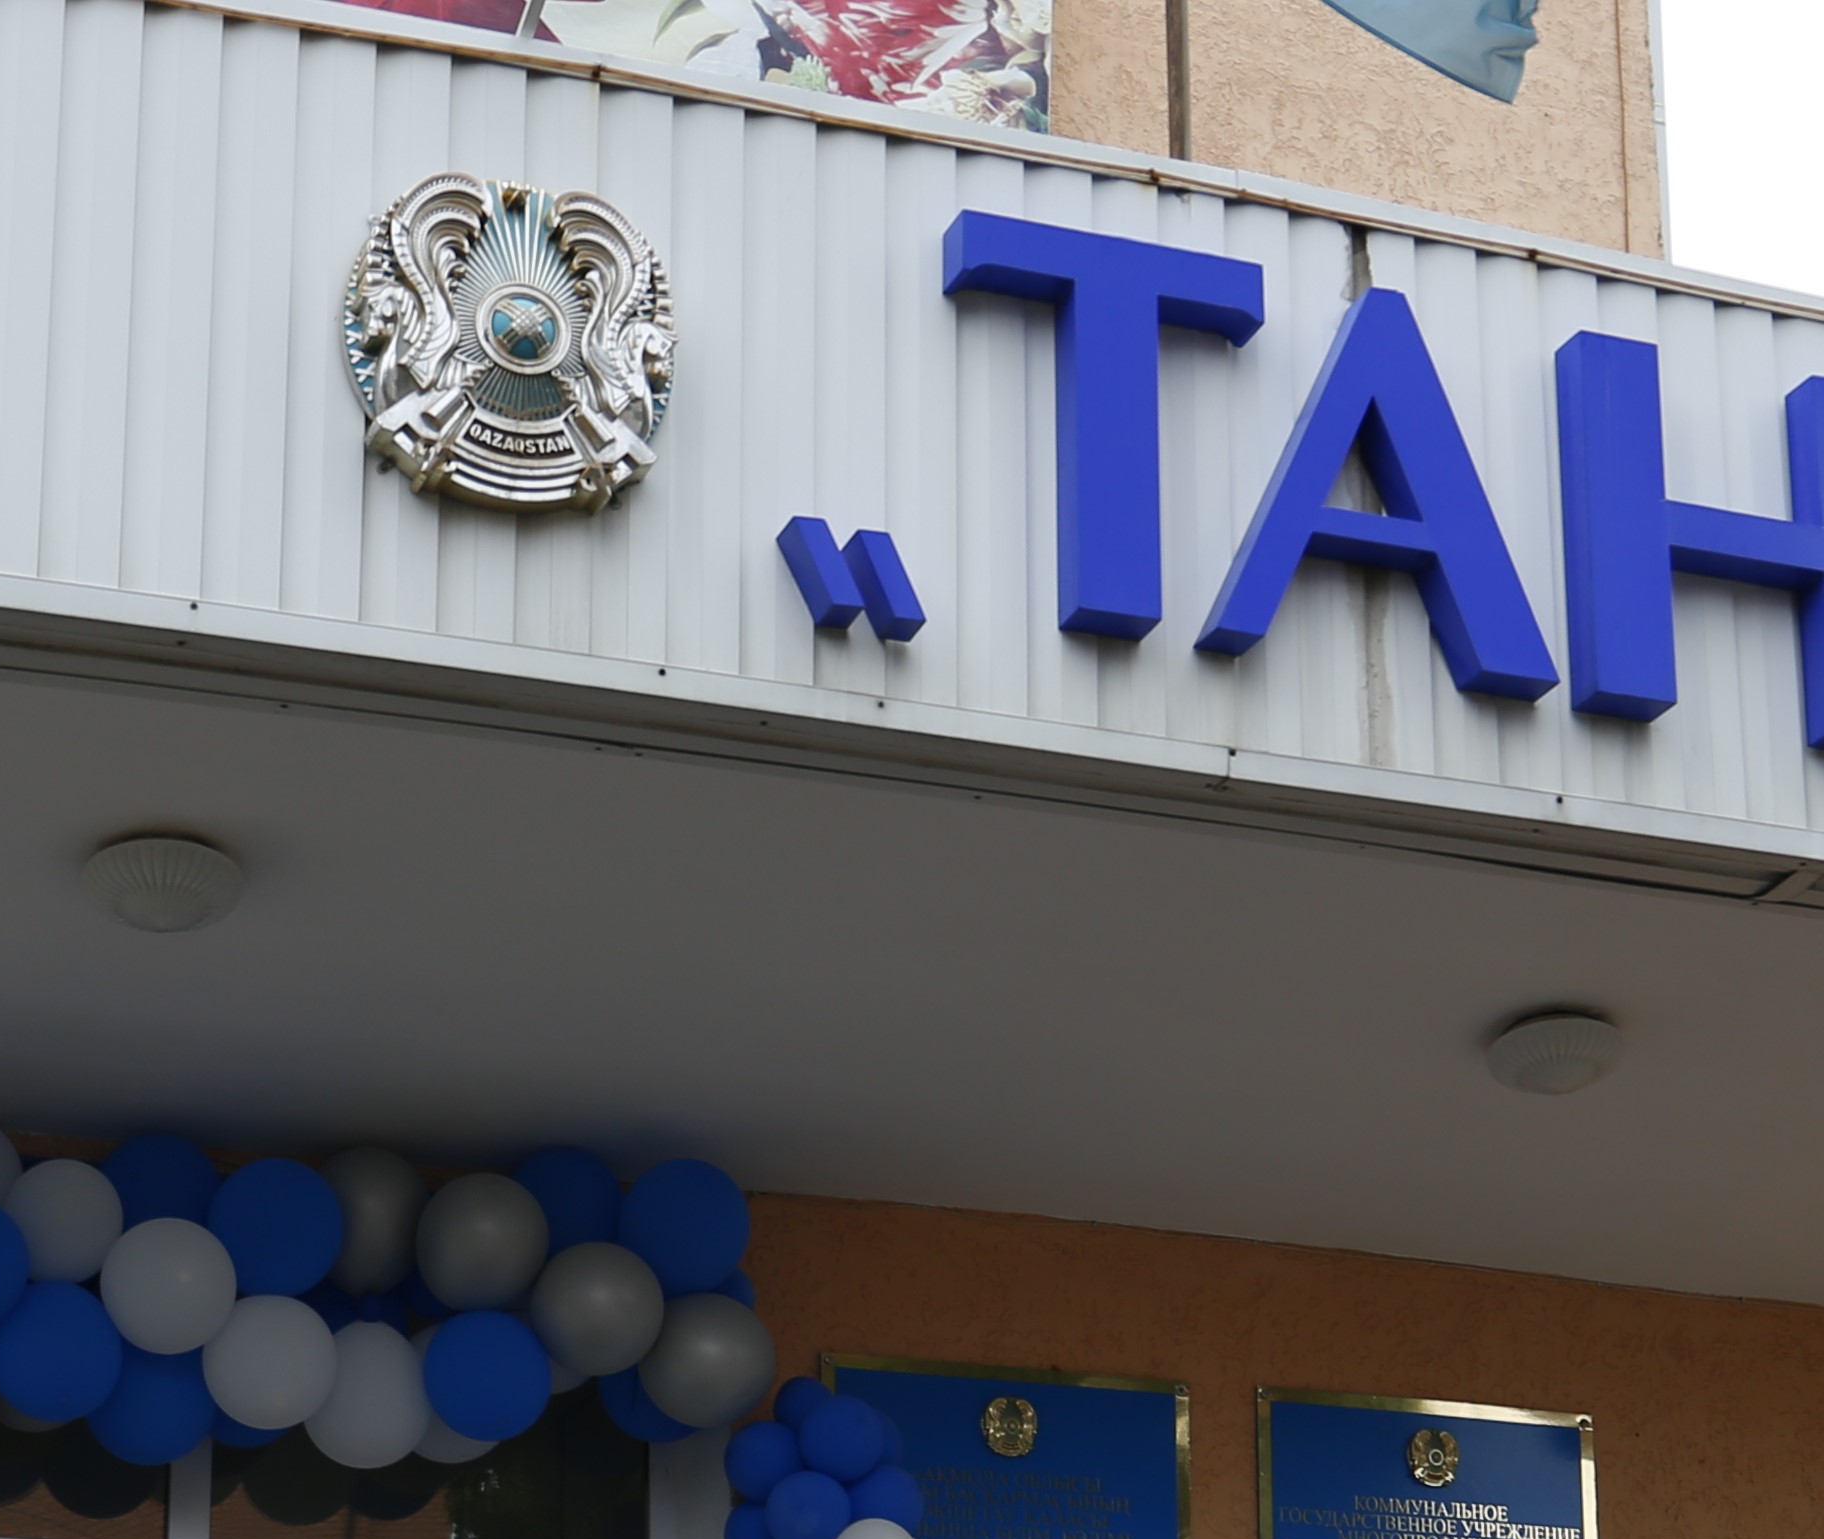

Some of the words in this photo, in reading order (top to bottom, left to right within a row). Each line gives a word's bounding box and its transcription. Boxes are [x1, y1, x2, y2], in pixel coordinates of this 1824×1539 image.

[468, 422, 571, 455] QAZAQSTAN
[1279, 1506, 1457, 1535] ГОСУДАРСТВЕННОЕ
[1354, 1495, 1508, 1523] КОММУНАЛЬНОЕ
